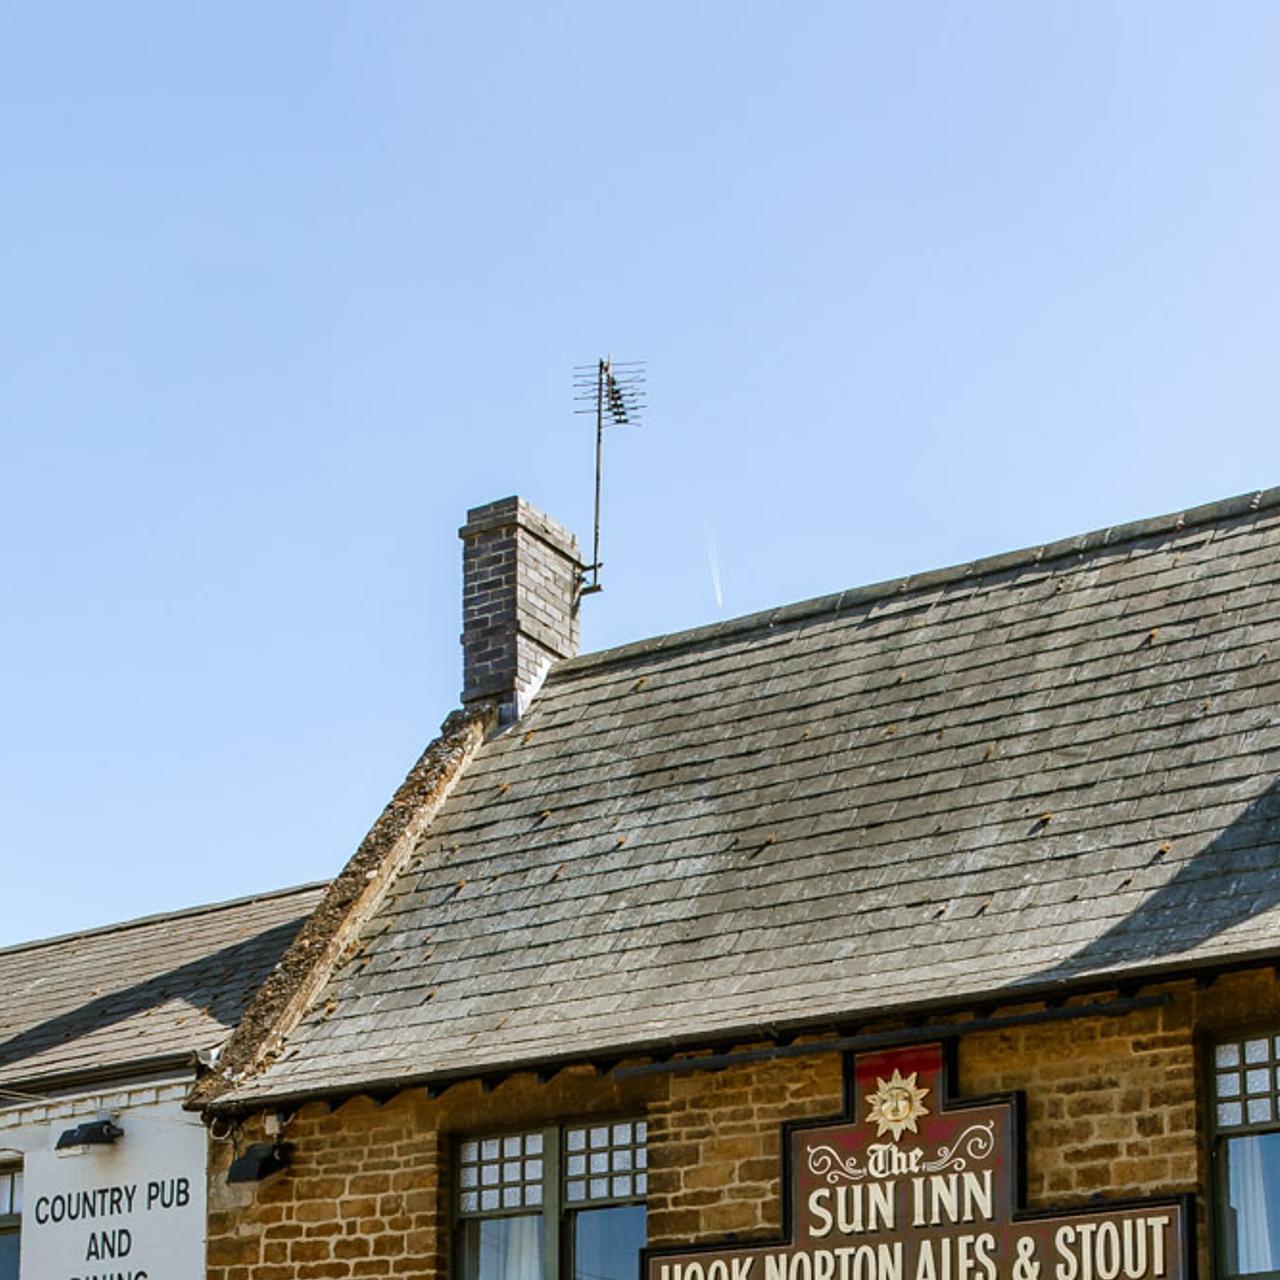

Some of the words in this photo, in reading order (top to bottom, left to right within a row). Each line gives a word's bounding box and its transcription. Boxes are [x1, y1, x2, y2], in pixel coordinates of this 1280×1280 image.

[866, 1142, 923, 1176] The
[35, 1184, 137, 1225] COUNTRY
[147, 1177, 190, 1211] PUB
[809, 1181, 895, 1236] SUN
[911, 1169, 994, 1226] INN
[85, 1228, 132, 1261] AND
